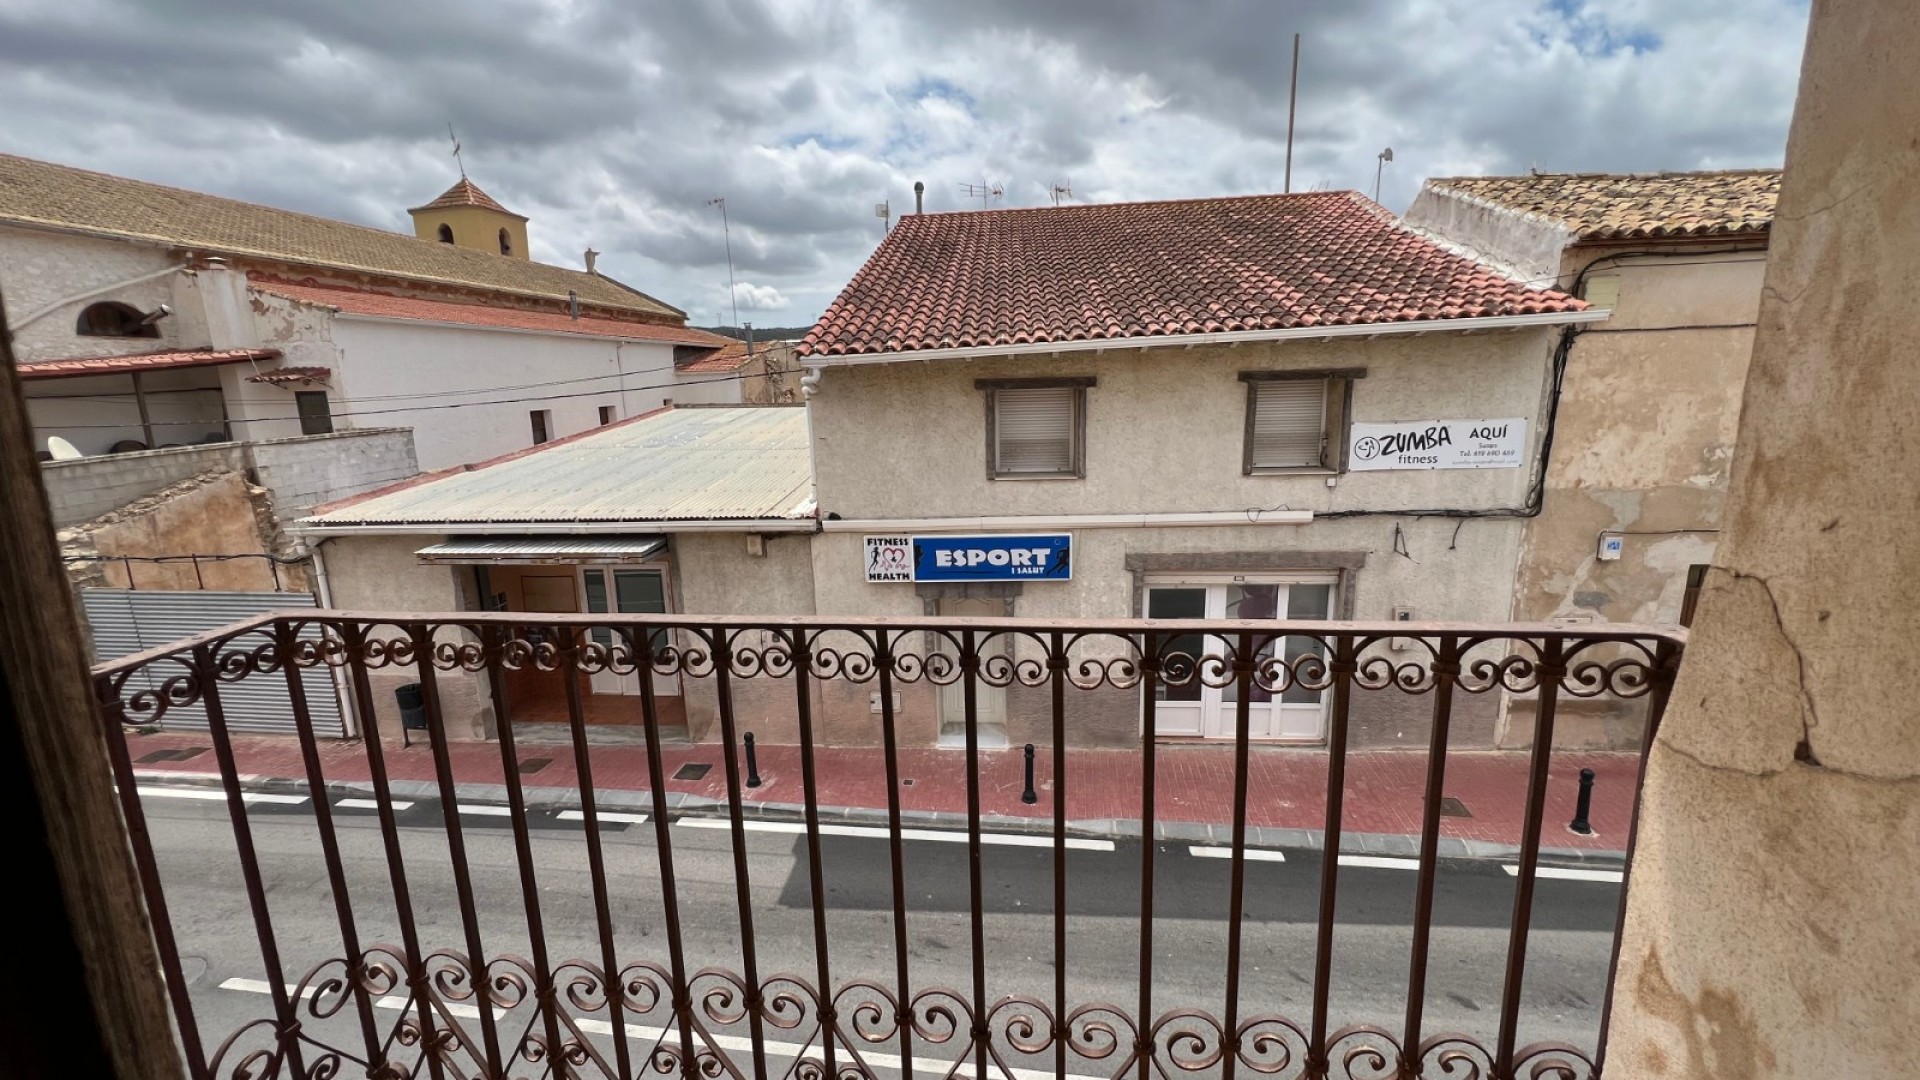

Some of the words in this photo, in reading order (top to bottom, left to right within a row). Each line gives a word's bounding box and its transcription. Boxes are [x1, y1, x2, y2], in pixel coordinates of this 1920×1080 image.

[1469, 424, 1508, 440] AQUÍ
[1379, 426, 1452, 456] ZUMBA
[1398, 455, 1438, 464] fitness
[867, 538, 909, 546] FITNESS
[935, 548, 1051, 567] ESPORT
[1017, 566, 1045, 574] SALUT
